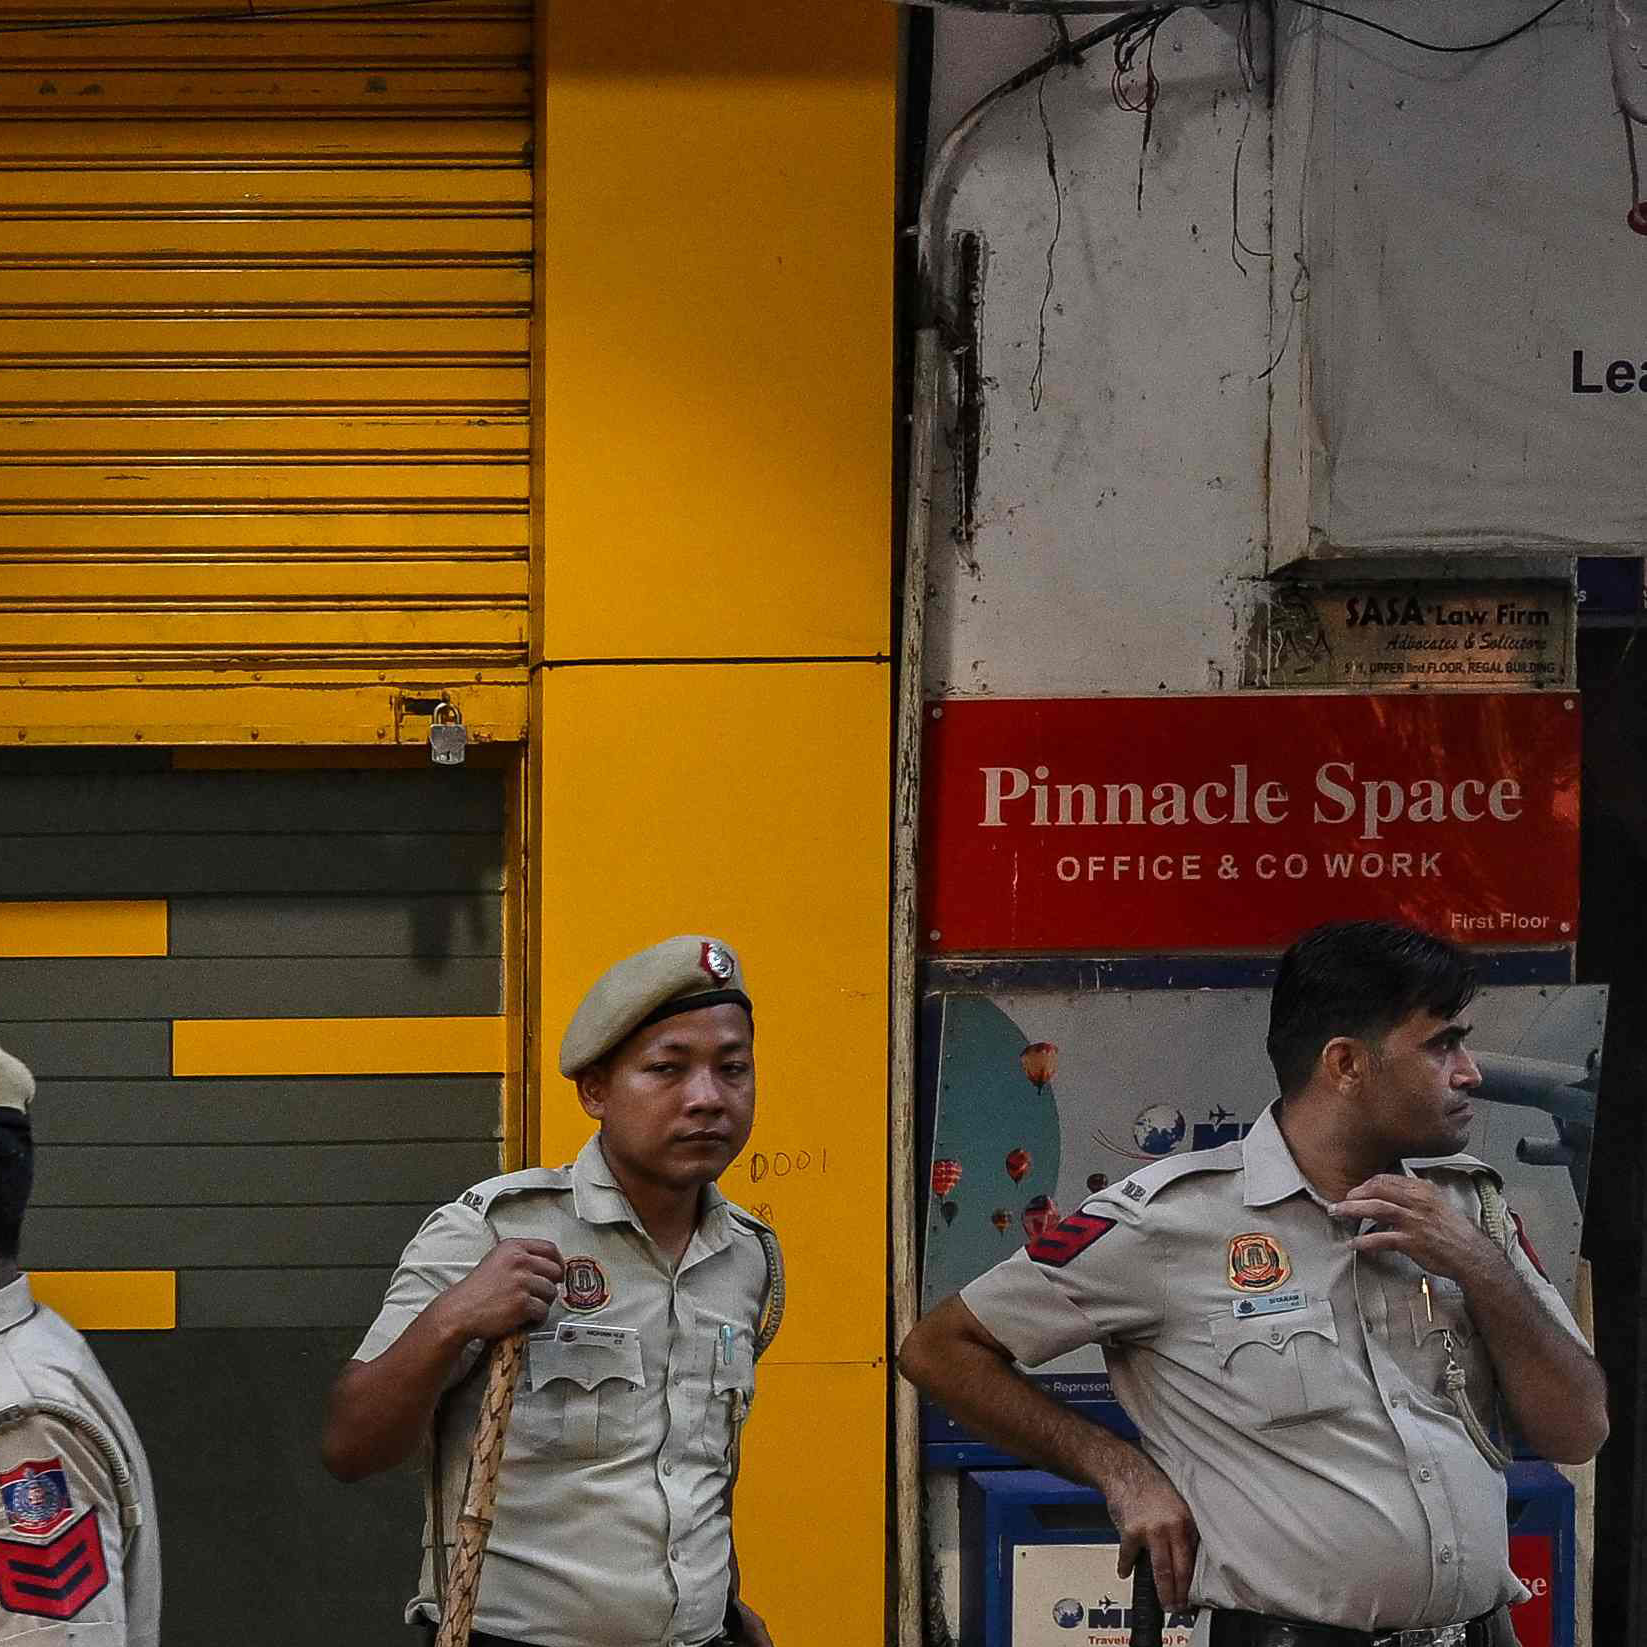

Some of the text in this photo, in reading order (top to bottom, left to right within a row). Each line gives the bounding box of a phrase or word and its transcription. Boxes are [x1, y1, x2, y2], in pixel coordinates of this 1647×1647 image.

[1434, 604, 1488, 626] Law
[1496, 602, 1550, 626] Firm
[1369, 662, 1404, 674] UPPER
[1467, 661, 1503, 674] REGAL
[1505, 661, 1555, 674] BUILDING
[977, 761, 1523, 840] Pinnacle Space
[1056, 851, 1444, 882] OFFICE & CO WORK
[1451, 911, 1551, 930] First Floor
